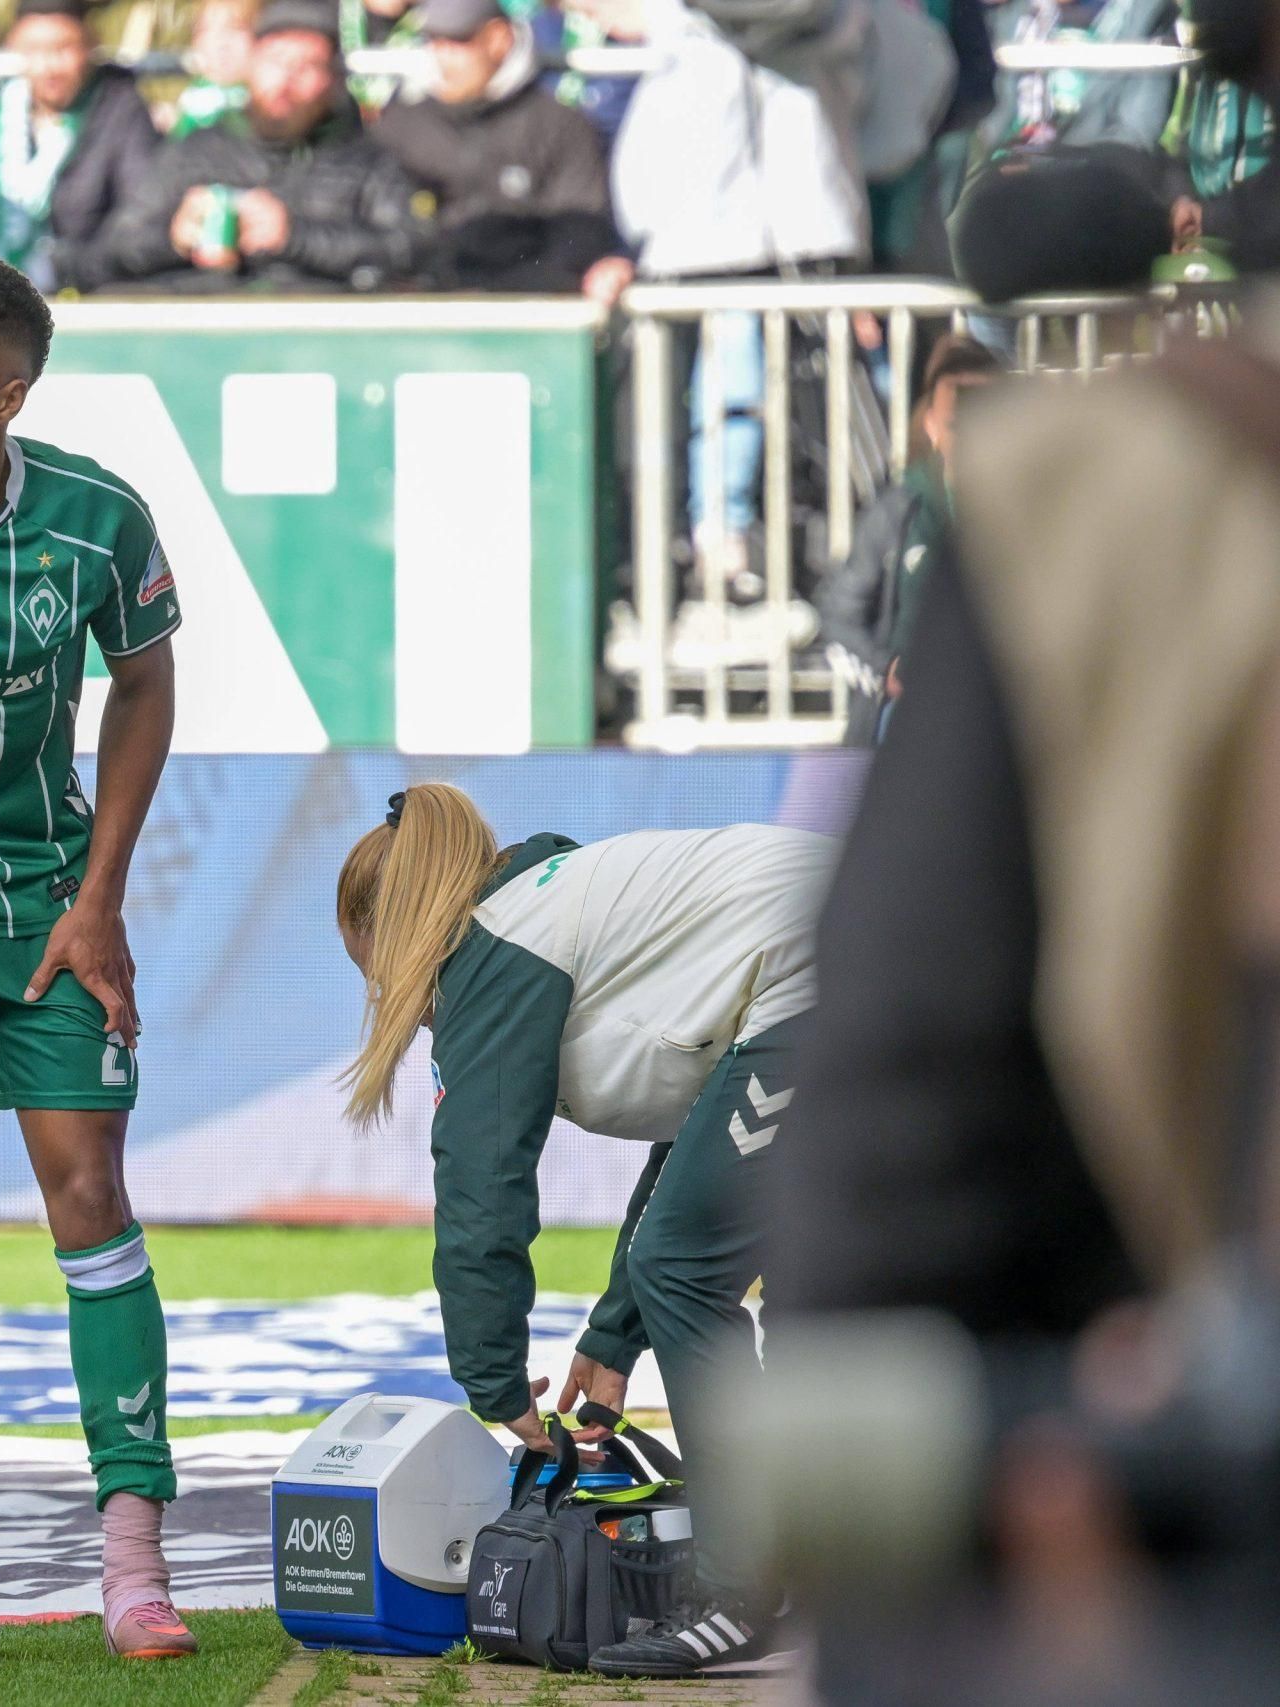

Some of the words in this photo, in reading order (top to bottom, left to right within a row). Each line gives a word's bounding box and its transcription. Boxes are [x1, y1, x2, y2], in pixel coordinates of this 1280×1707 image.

[323, 1445, 349, 1459] AOK
[284, 1518, 332, 1553] AOK
[285, 1565, 300, 1576] AOK
[300, 1566, 366, 1581] Bremen/Bremerhaven
[285, 1581, 296, 1592] Die
[297, 1582, 355, 1595] Gesundheitskasse.
